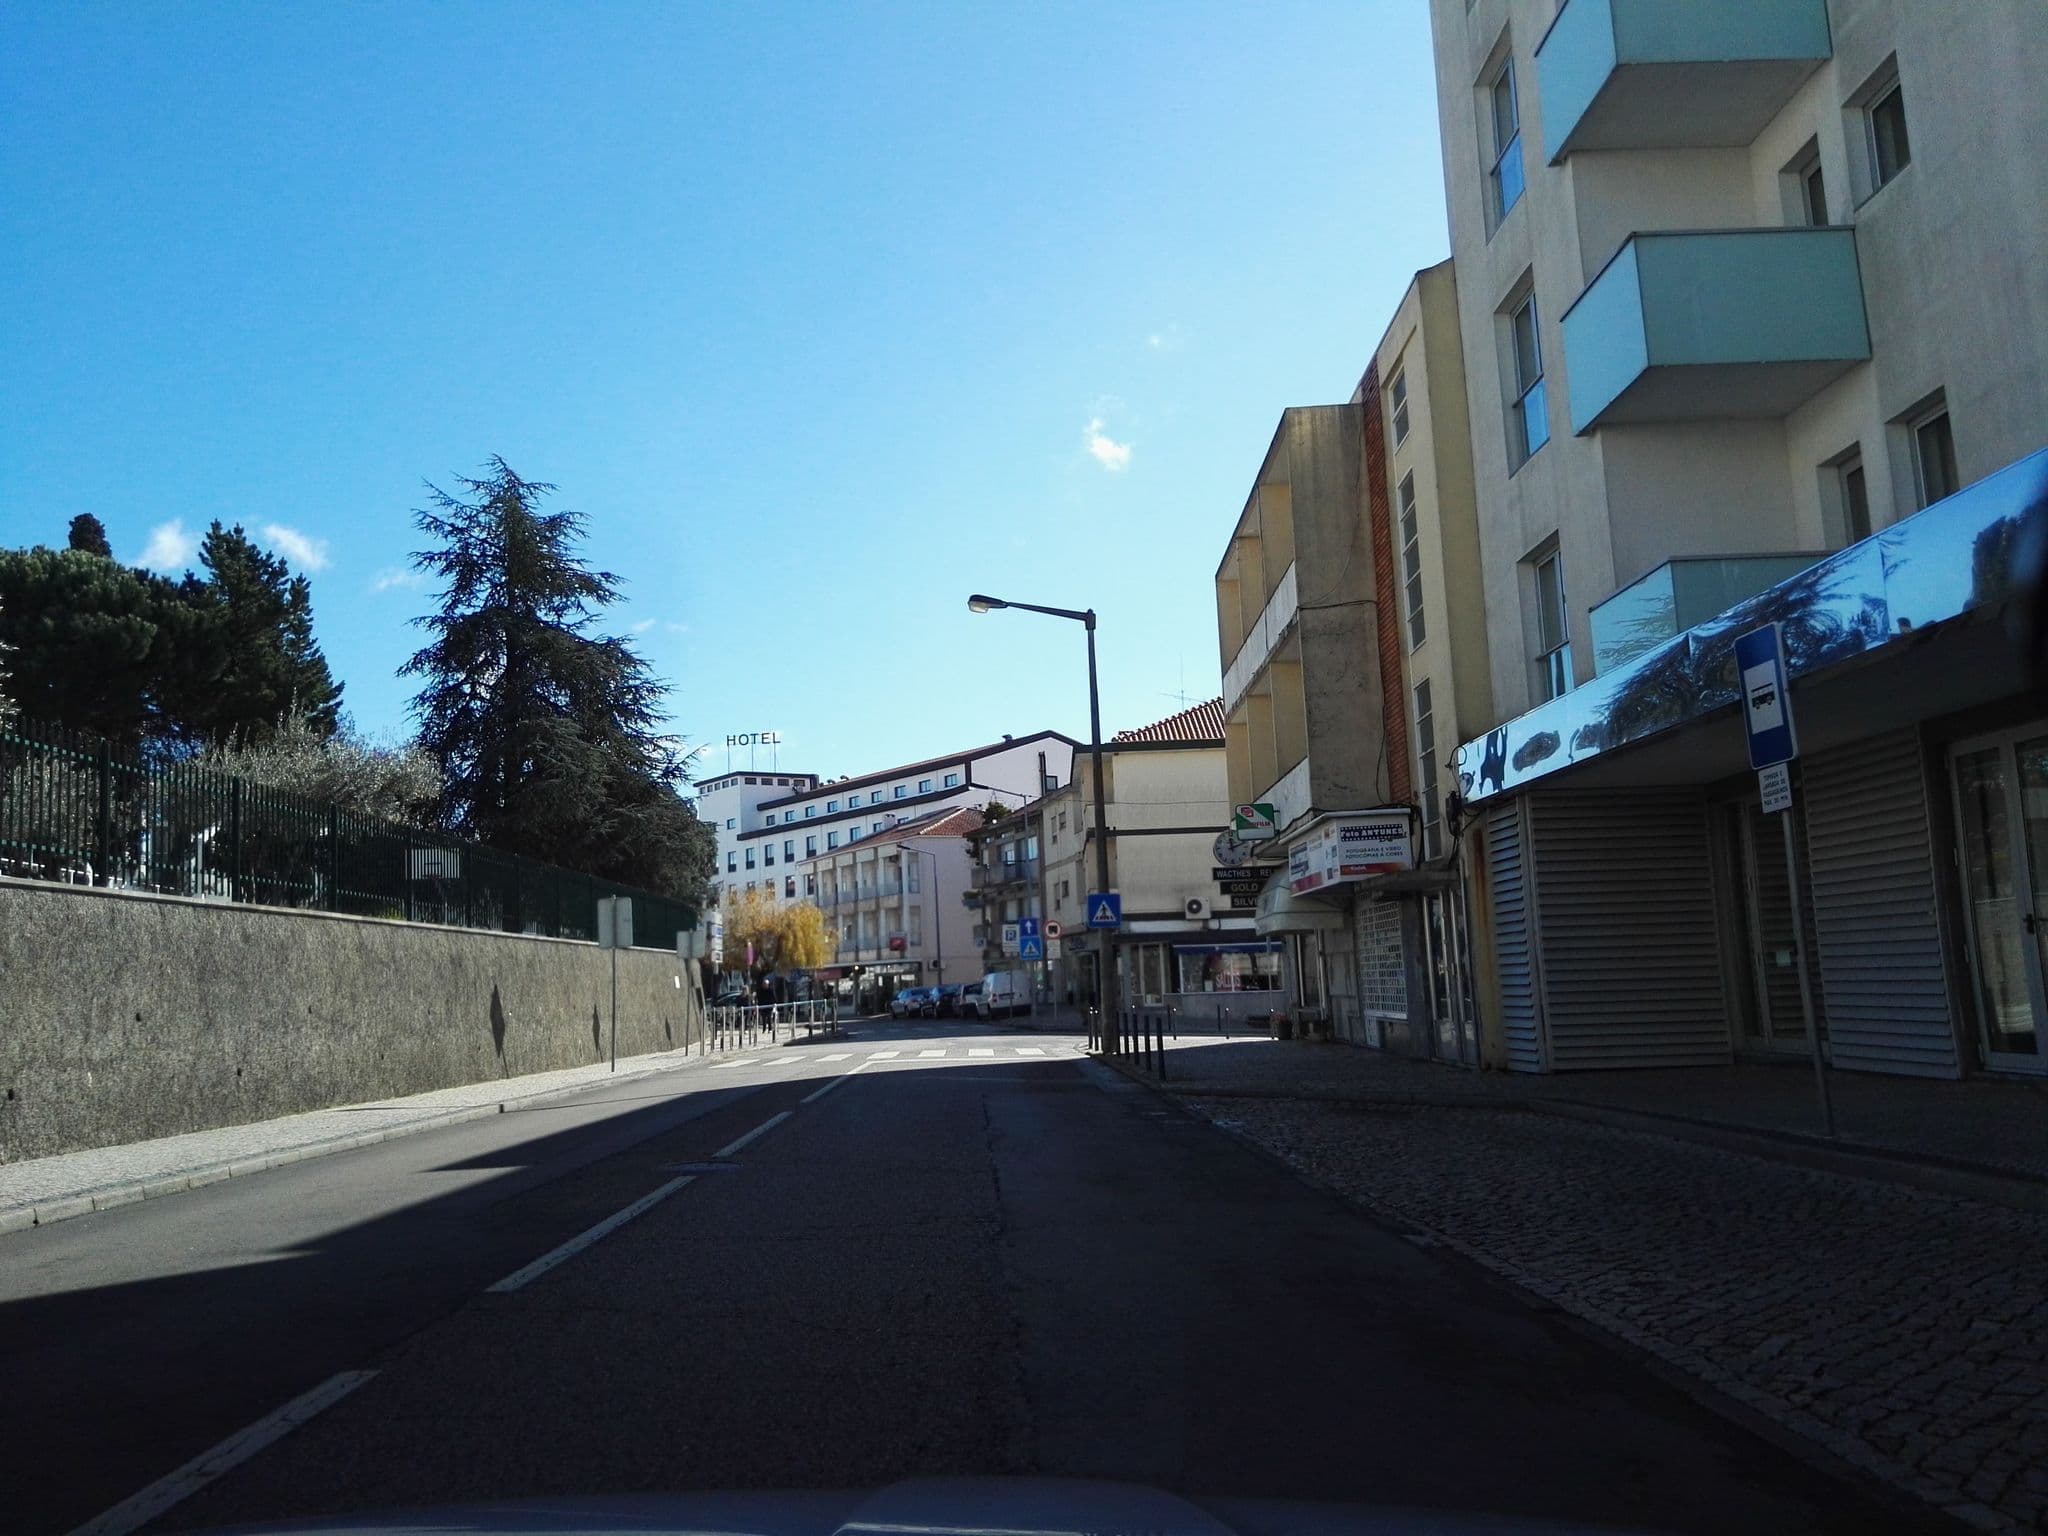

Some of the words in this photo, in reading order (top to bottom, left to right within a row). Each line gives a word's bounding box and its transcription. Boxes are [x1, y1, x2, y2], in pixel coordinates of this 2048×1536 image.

[727, 732, 781, 746] HOTEL
[1361, 828, 1403, 836] ANTUNES
[1231, 883, 1258, 892] GOLD
